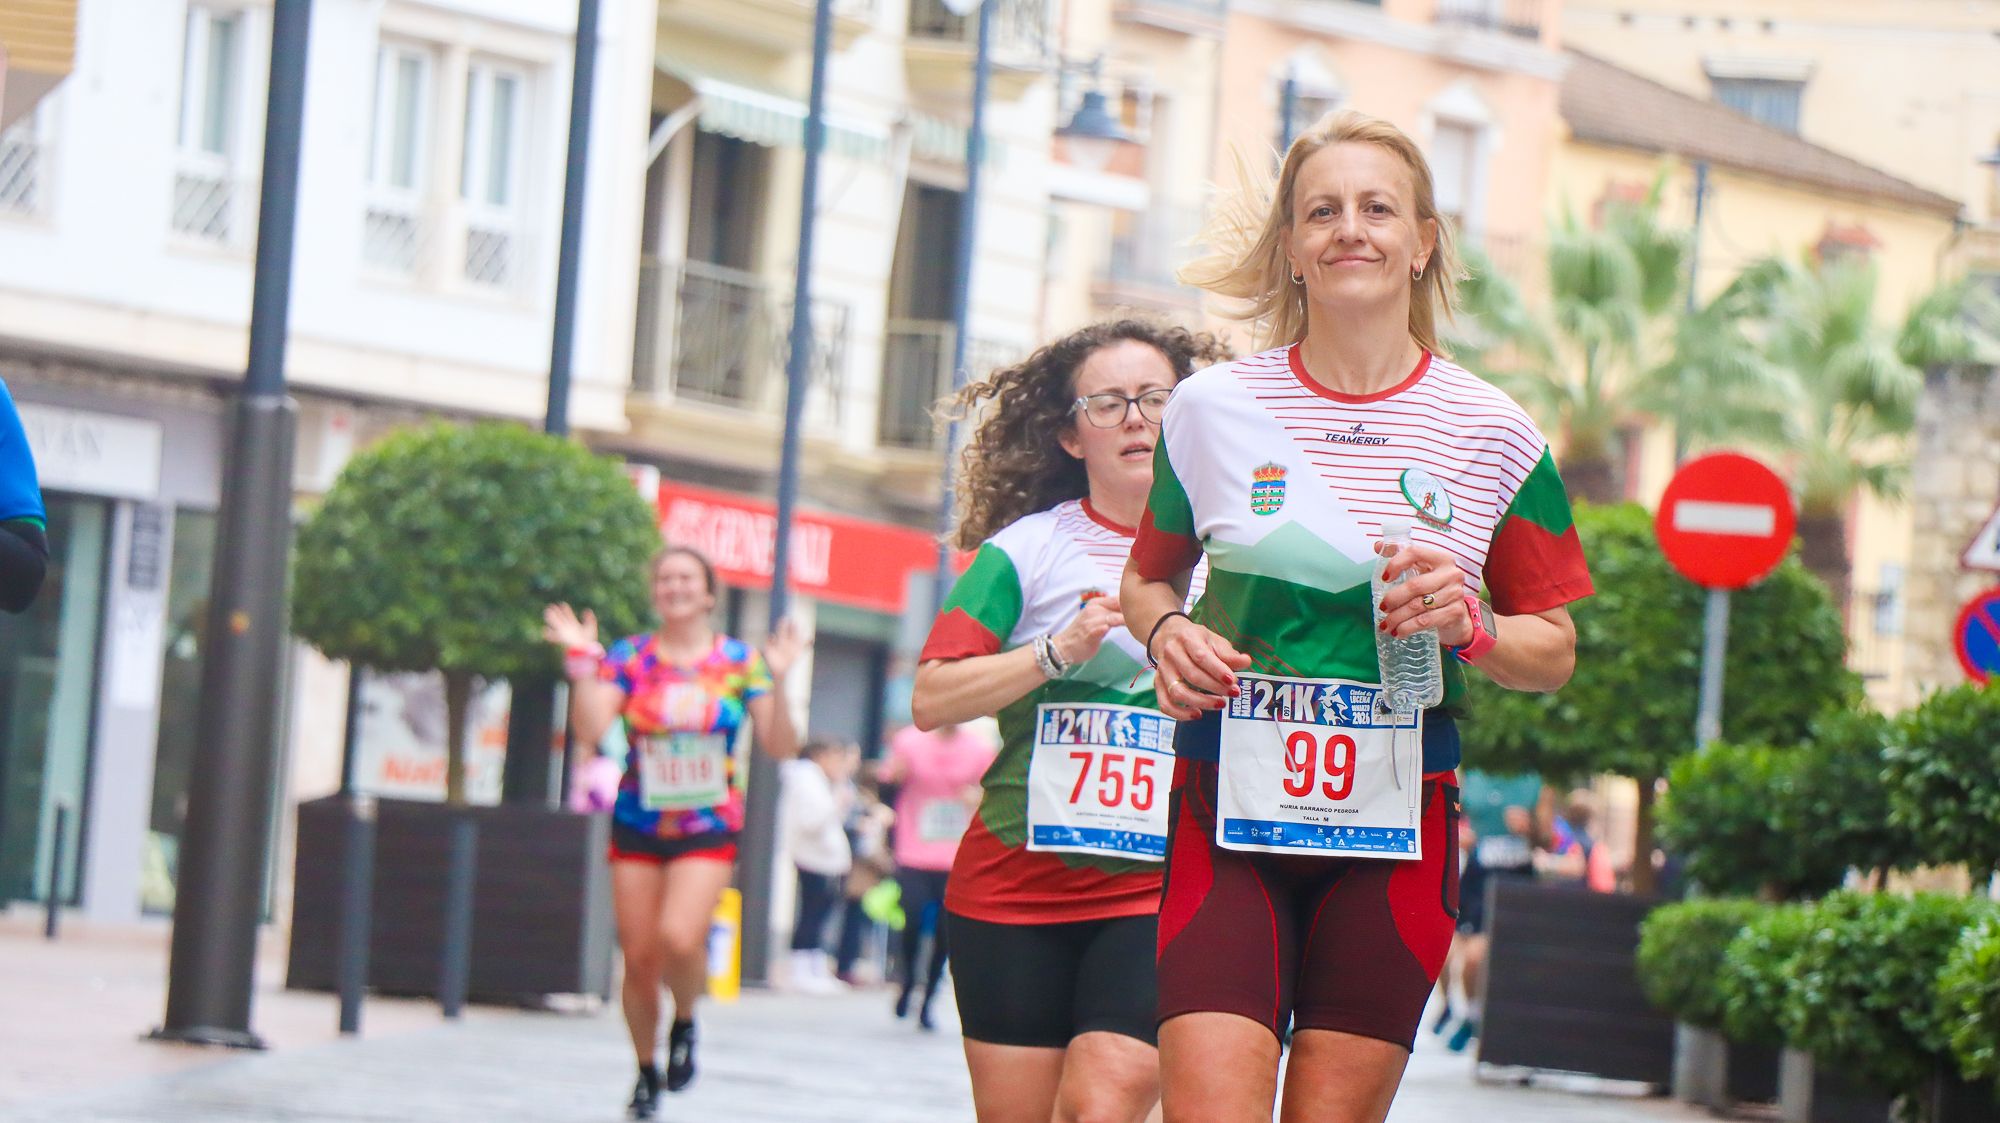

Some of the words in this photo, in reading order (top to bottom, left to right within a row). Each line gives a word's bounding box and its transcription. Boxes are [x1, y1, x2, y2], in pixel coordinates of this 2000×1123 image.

[1325, 433, 1390, 445] TEAMERGY
[704, 505, 832, 587] GENEALI
[1231, 696, 1241, 716] MEDI
[1240, 679, 1252, 717] MARATÓN
[1254, 680, 1315, 722] 21K
[1350, 696, 1371, 704] LUCENA
[1059, 709, 1110, 744] 21K
[1352, 711, 1371, 725] 2026
[1069, 752, 1155, 811] 755
[1283, 731, 1356, 801] 99
[1300, 805, 1332, 813] BARRANCO
